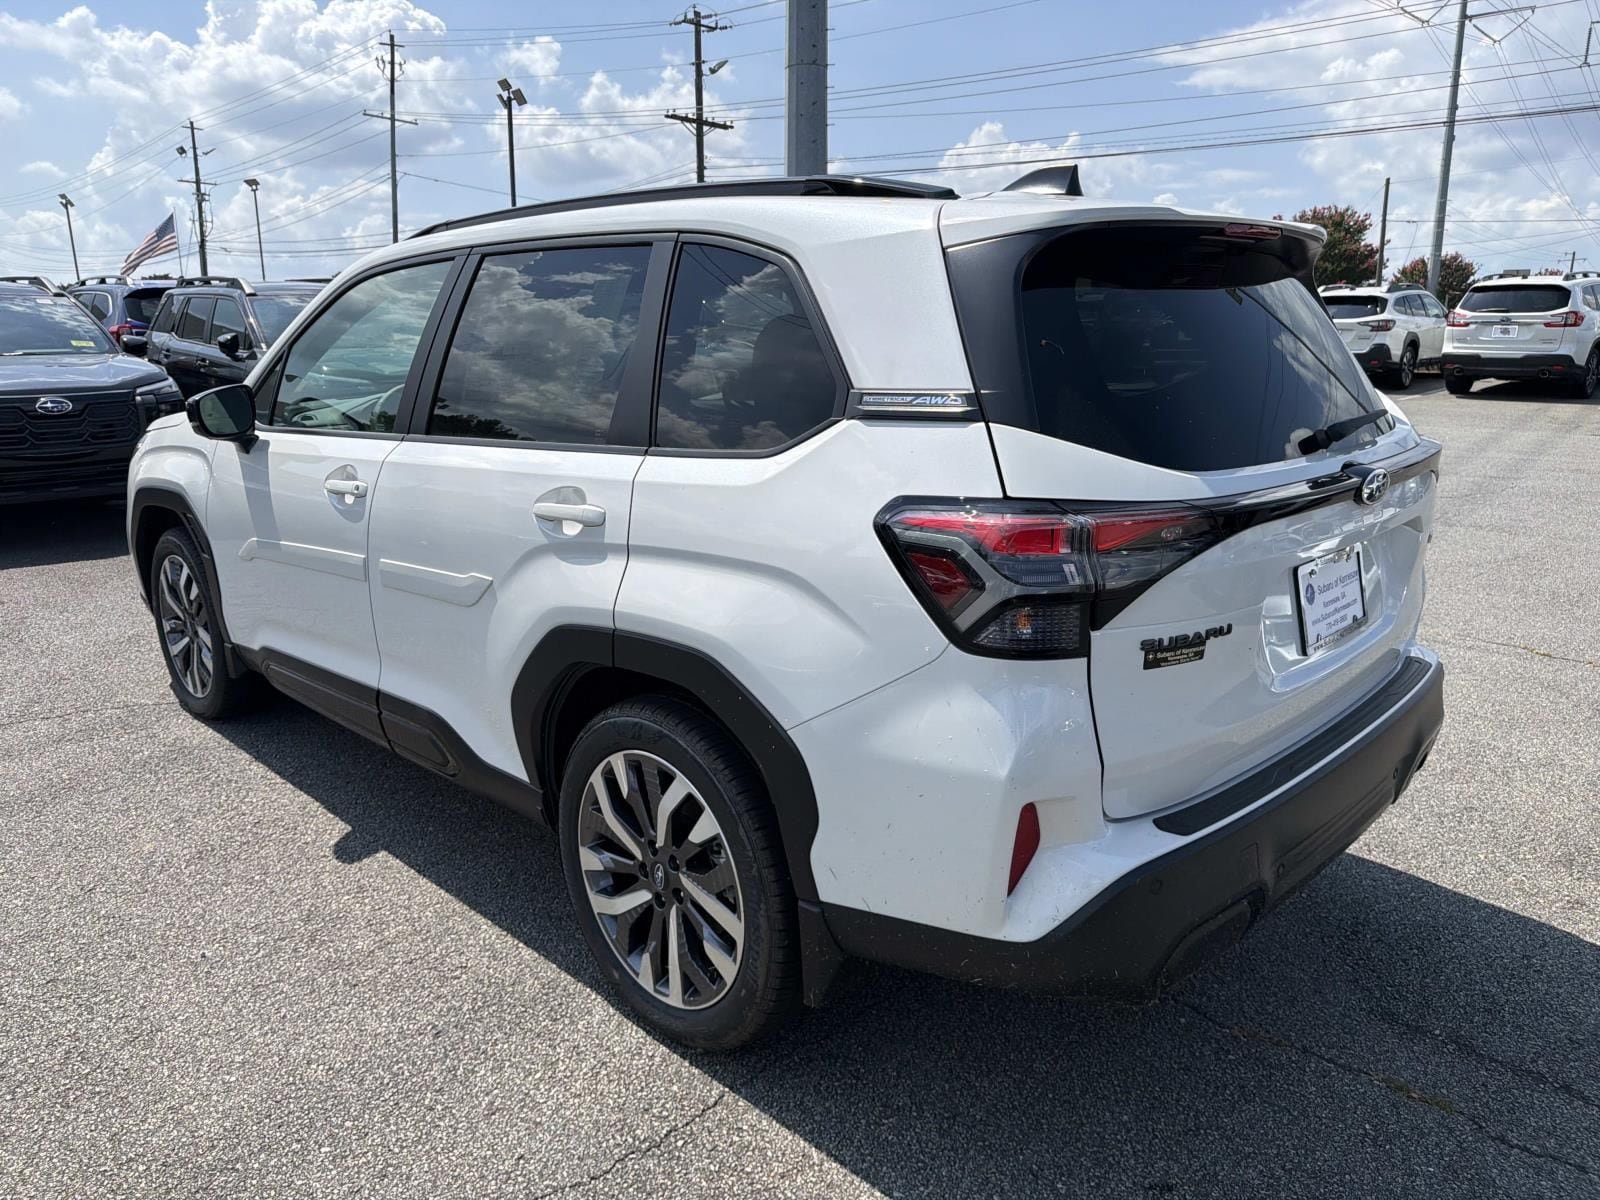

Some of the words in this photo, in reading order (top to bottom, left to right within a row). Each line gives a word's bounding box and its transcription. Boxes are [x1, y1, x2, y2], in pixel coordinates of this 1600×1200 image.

[912, 395, 962, 405] AWD
[1317, 582, 1334, 595] Subaru
[1140, 623, 1233, 650] SUBARU
[1156, 651, 1175, 659] Subaru
